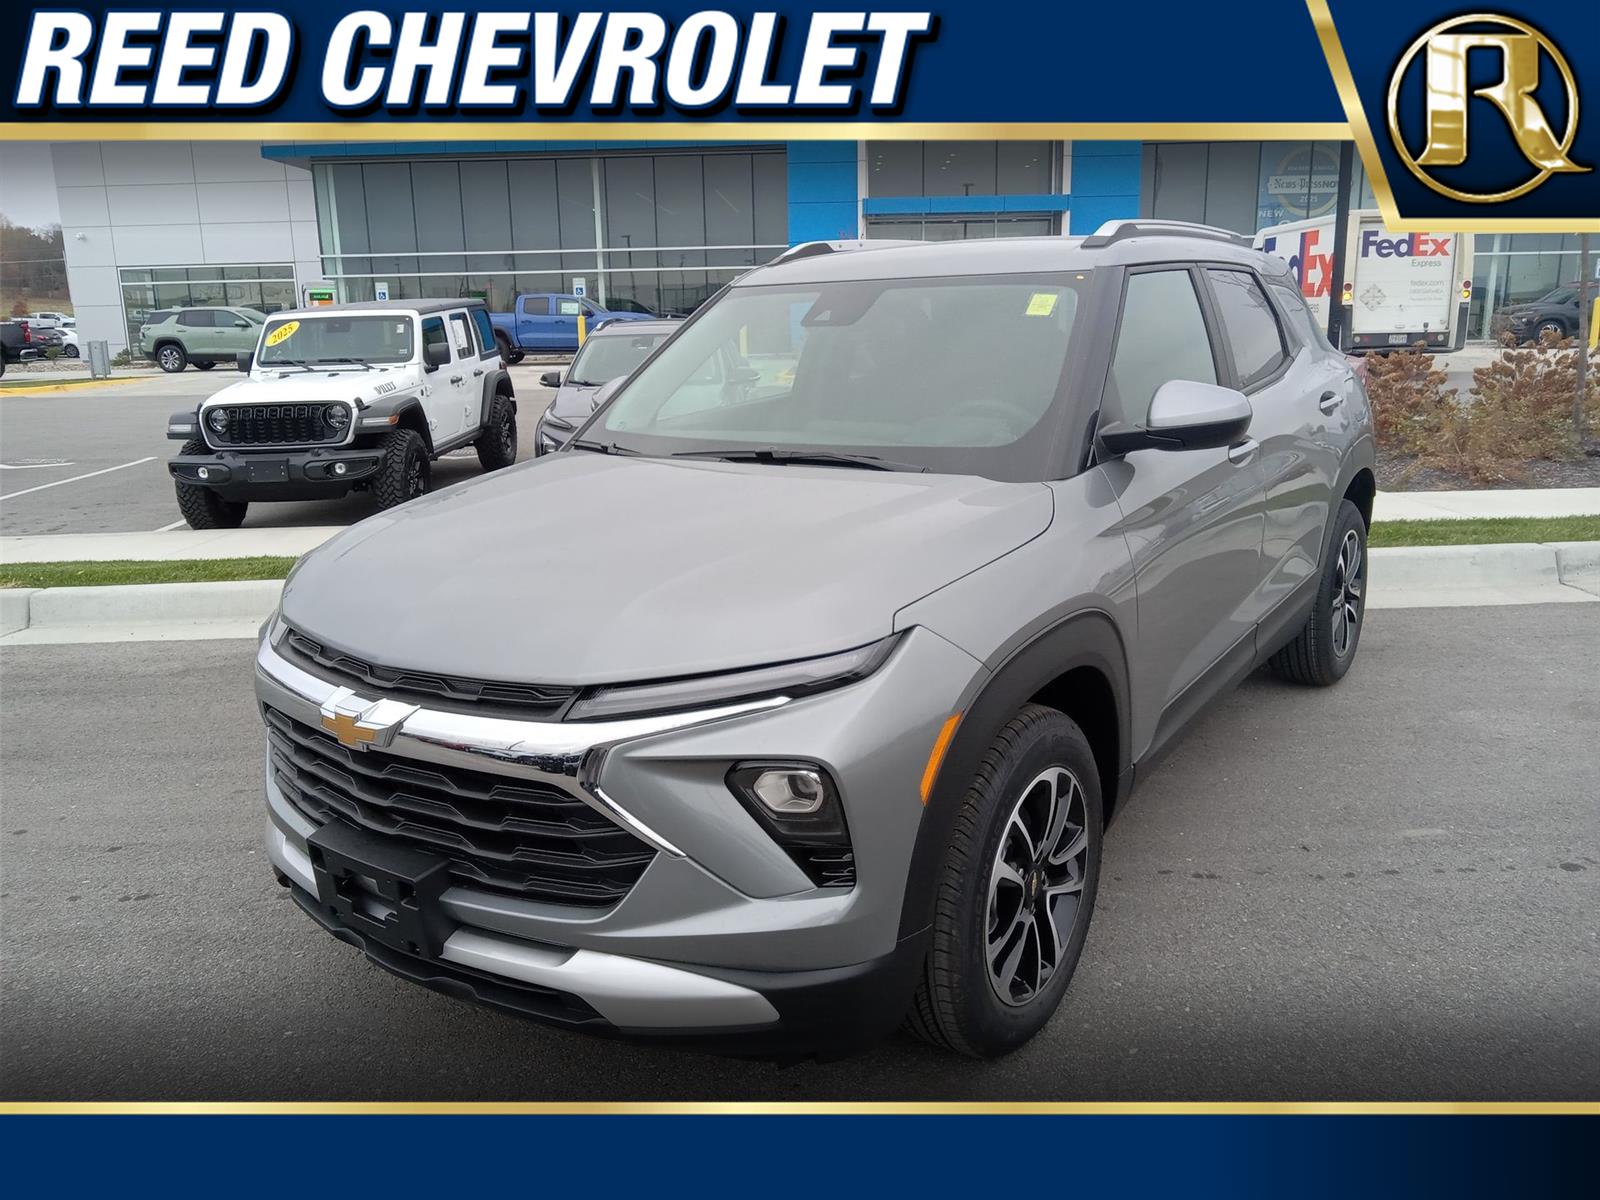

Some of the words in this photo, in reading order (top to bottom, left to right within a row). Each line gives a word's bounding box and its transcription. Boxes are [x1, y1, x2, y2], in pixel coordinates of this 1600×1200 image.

[1258, 209, 1285, 218] NEW
[1361, 230, 1451, 258] FedEx
[1411, 259, 1442, 268] Express
[272, 323, 293, 344] 2025
